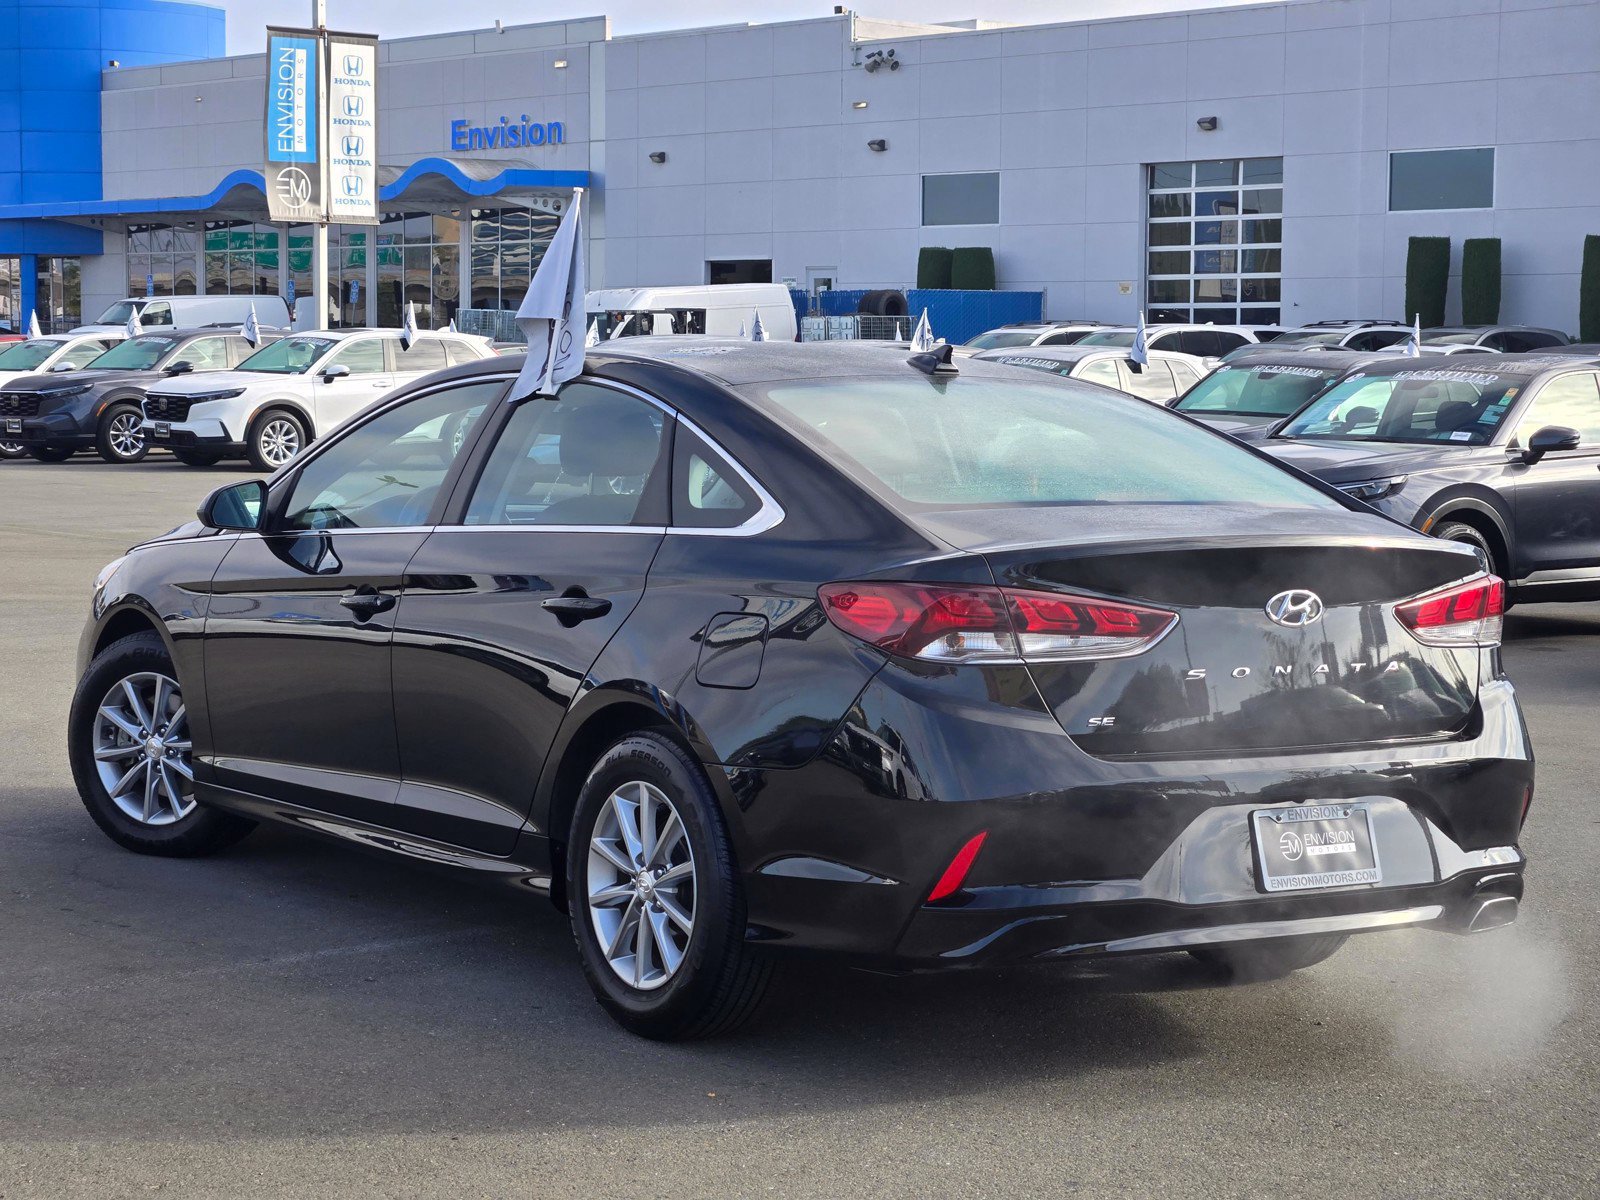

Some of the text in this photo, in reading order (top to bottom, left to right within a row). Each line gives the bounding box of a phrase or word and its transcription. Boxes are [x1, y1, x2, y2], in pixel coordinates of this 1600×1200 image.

[334, 78, 371, 87] HONDA
[278, 47, 296, 153] ENVISION
[333, 118, 371, 127] HONDA
[451, 114, 564, 150] Envision
[333, 158, 372, 167] HONDA
[335, 198, 371, 206] HONDA
[1413, 371, 1499, 381] CERTIFIED
[1185, 660, 1400, 681] SONATA
[1087, 716, 1116, 727] SE
[630, 749, 672, 777] SEASON
[1287, 806, 1340, 821] ENVISION
[1304, 830, 1355, 847] ENVISION
[1270, 871, 1377, 889] ENVISIONMOTORS.COM
